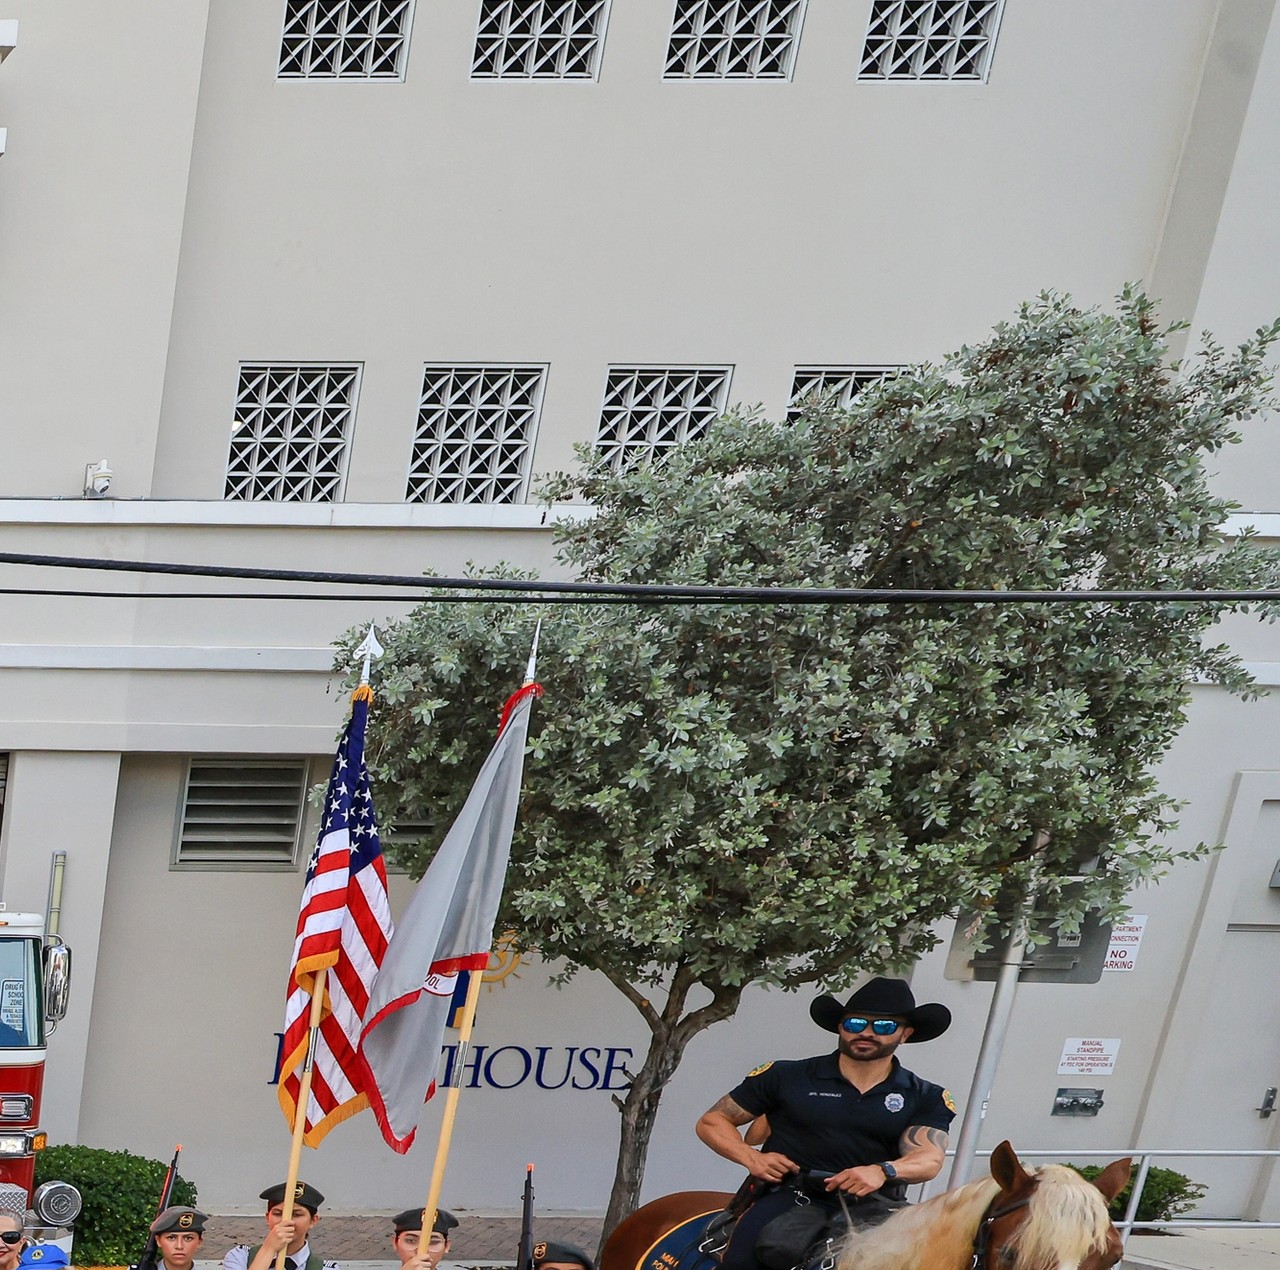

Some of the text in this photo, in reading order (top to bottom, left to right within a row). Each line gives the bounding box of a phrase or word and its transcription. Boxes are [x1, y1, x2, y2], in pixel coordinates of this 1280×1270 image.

[1111, 934, 1139, 942] ONNECTION
[1110, 950, 1127, 959] NO
[1104, 960, 1133, 970] ARKING
